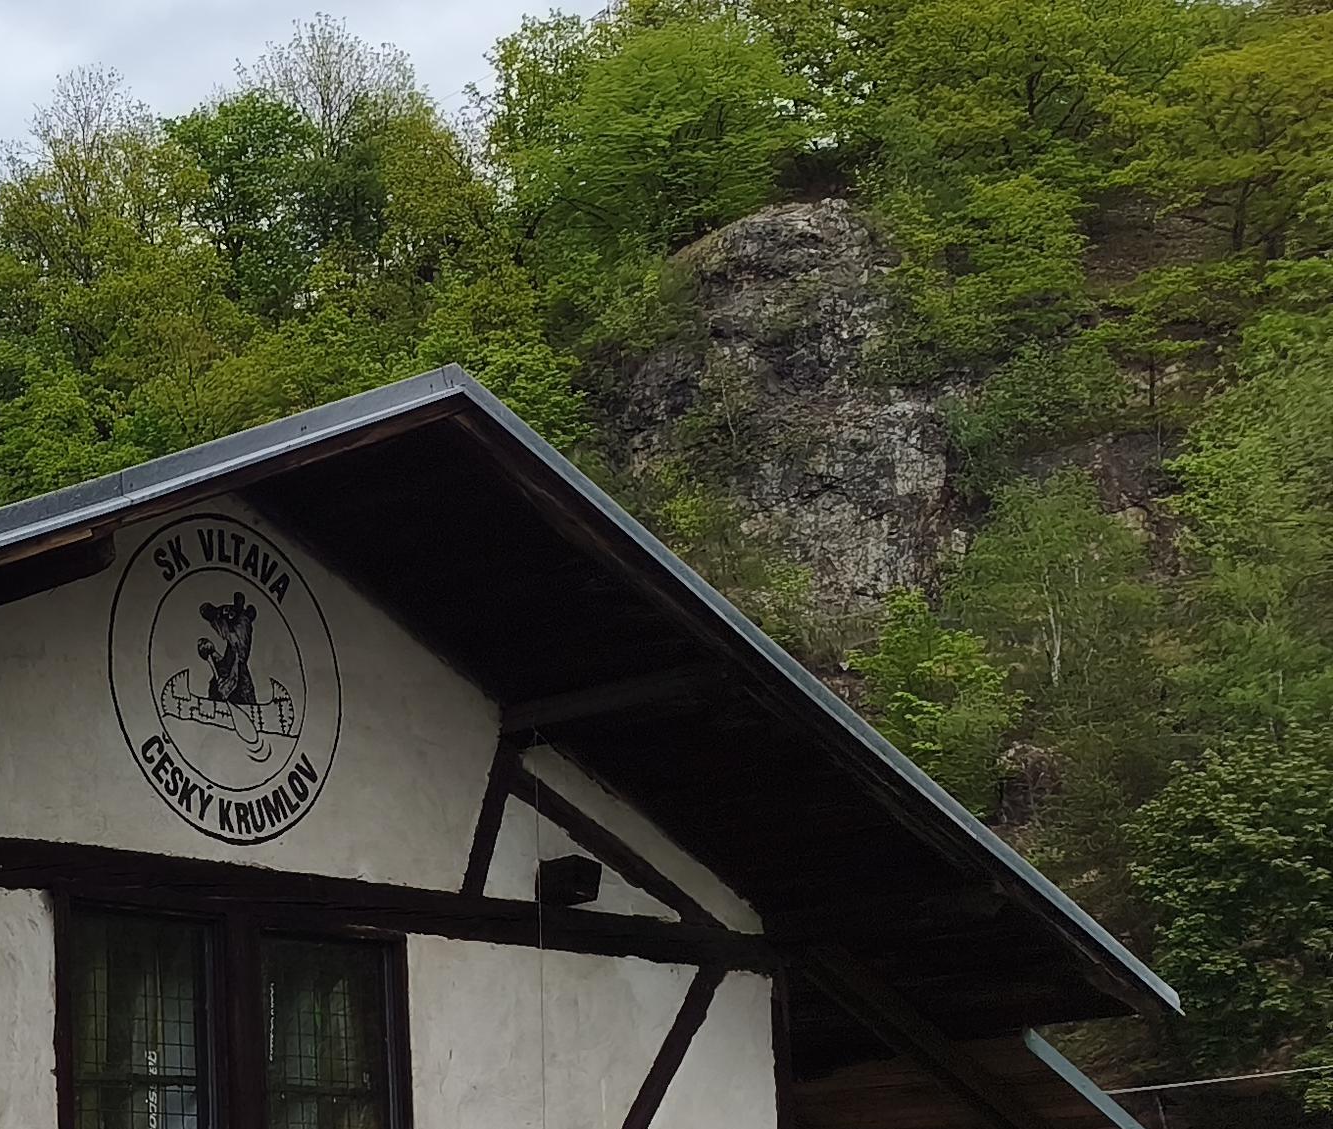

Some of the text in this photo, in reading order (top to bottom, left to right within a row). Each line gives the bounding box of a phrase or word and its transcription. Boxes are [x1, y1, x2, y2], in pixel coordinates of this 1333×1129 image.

[153, 529, 291, 604] SK VLTAVA
[140, 731, 319, 835] ČESKÝ KRUMLOV
